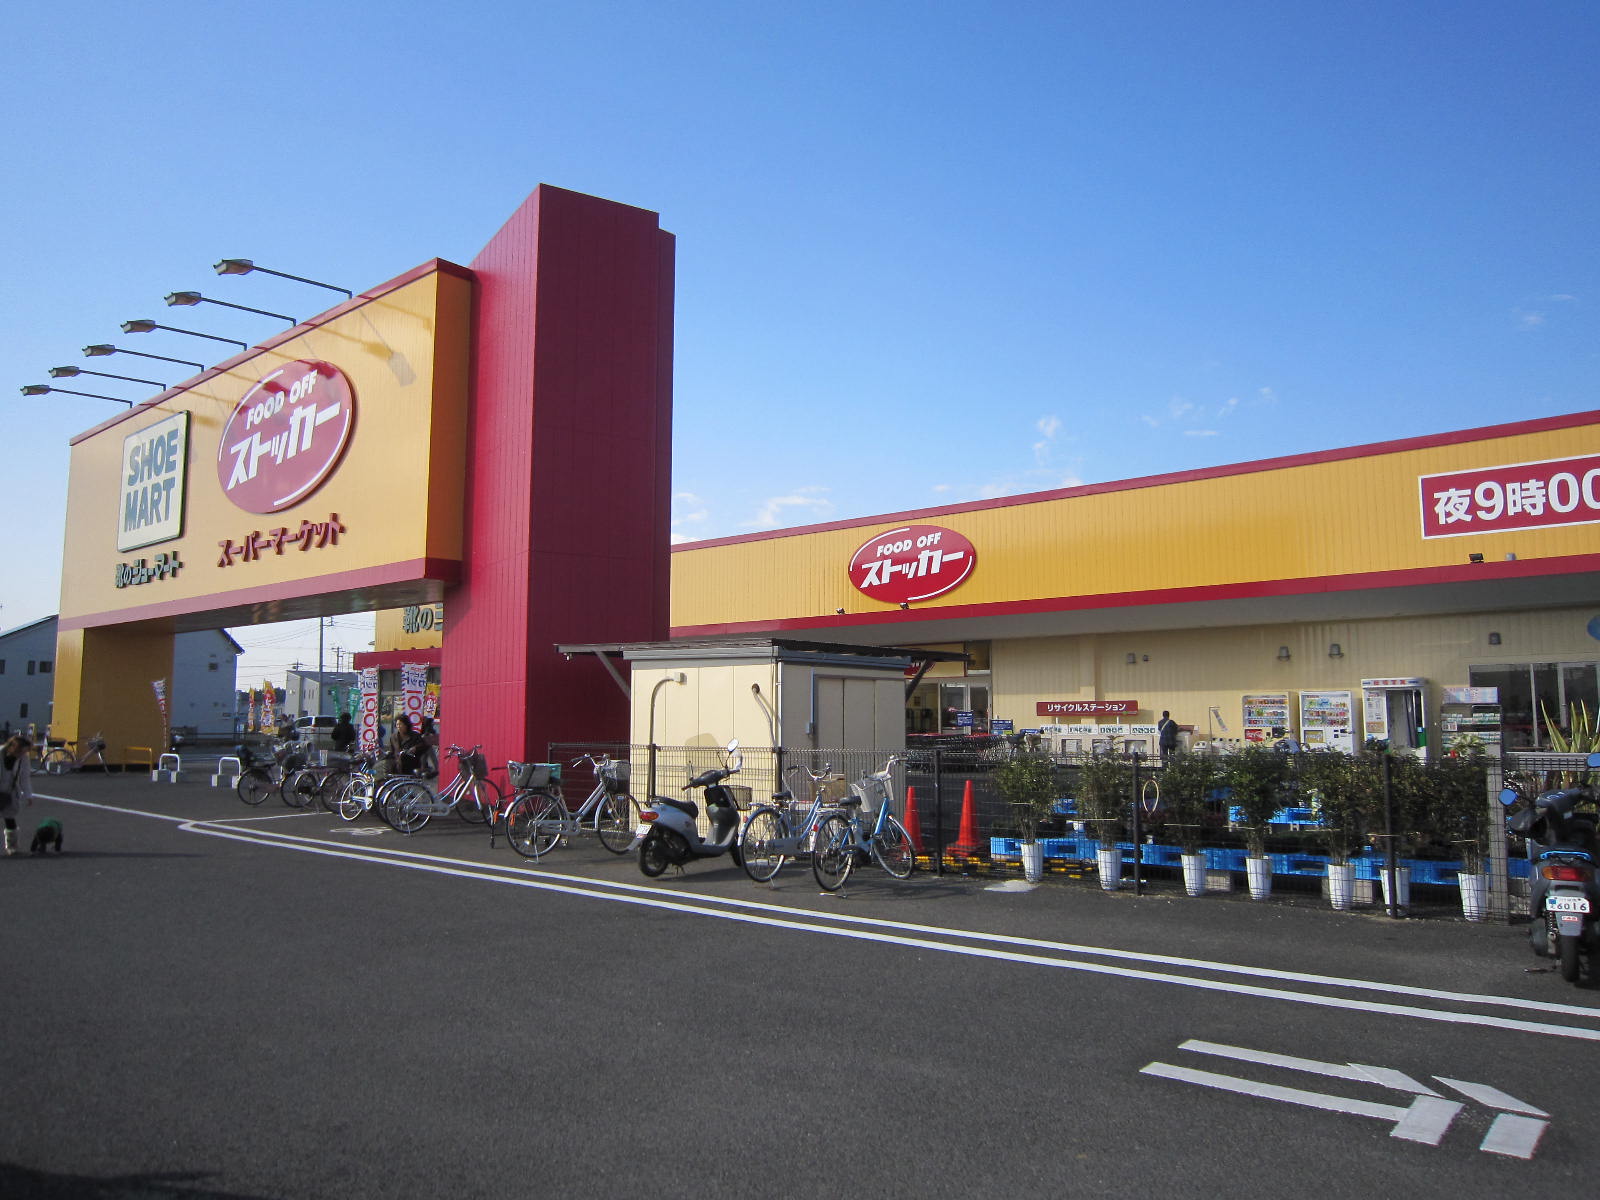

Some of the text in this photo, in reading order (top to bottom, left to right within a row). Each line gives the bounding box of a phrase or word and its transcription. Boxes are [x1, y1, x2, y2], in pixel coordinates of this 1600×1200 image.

[246, 369, 318, 430] FOOD OFF
[128, 429, 179, 487] SHOE
[227, 399, 341, 491] ストッカー
[124, 478, 176, 533] MART
[217, 513, 345, 568] スーパーマーケット
[876, 532, 942, 557] FOOD OFF
[859, 549, 964, 589] ストッカー
[1047, 703, 1127, 713] リサイクルステーション
[1557, 903, 1587, 911] 6016
